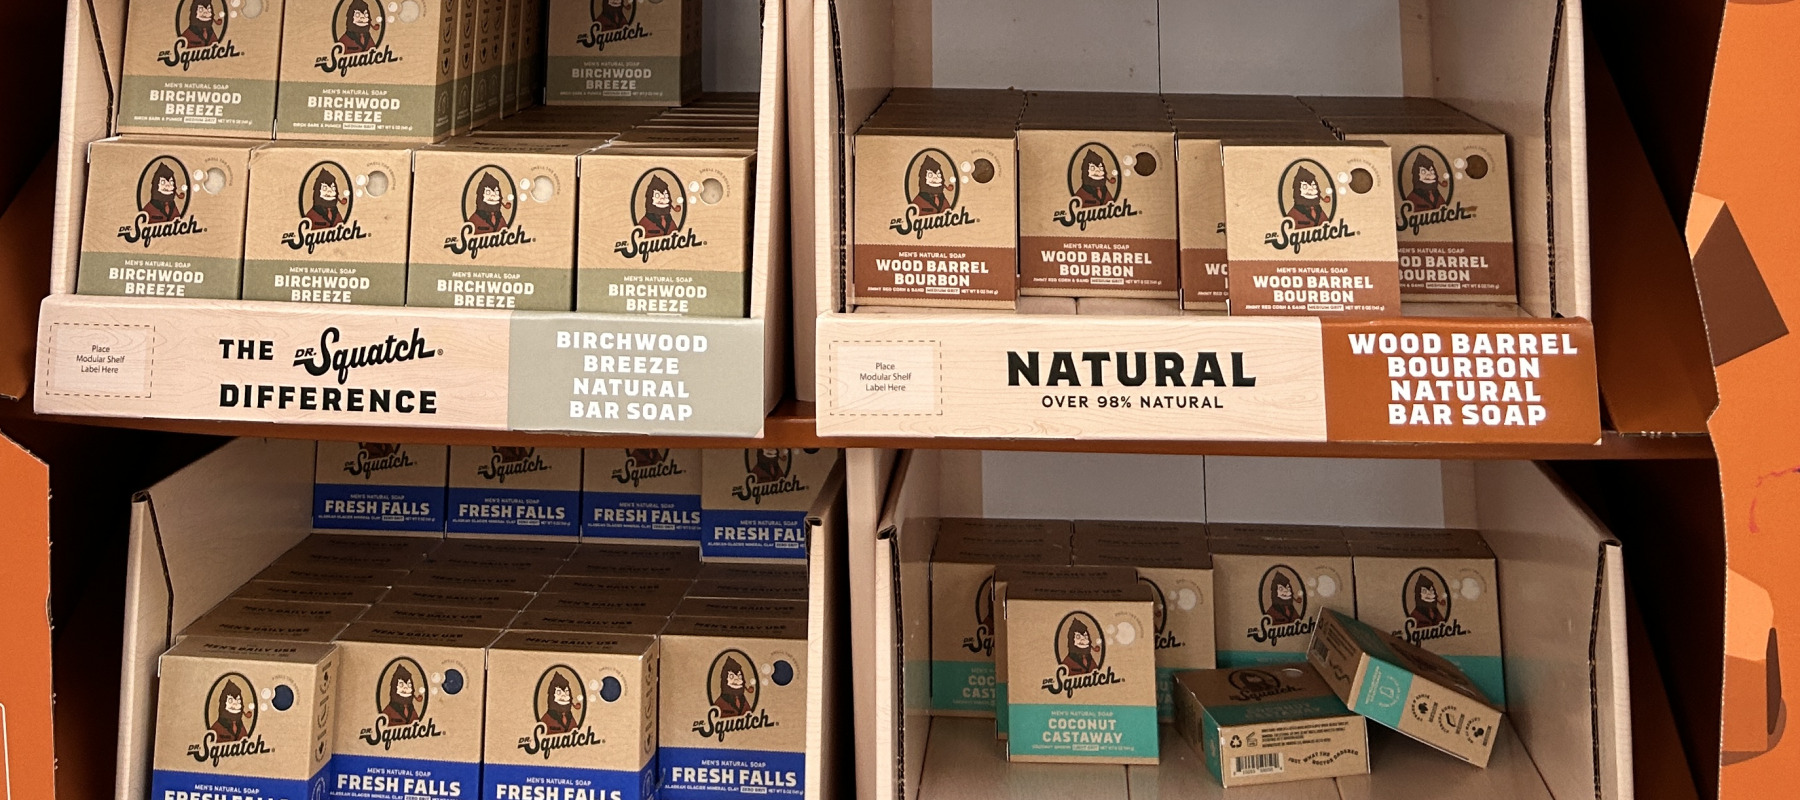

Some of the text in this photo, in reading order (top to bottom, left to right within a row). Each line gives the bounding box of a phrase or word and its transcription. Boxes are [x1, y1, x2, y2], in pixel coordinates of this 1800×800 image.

[572, 68, 652, 78] BIRCHWOOD
[586, 80, 636, 90] BREEZE
[150, 90, 241, 104] BIRCHWOOD
[308, 96, 400, 110] BIRCHWOOD
[165, 103, 224, 116] BREEZE
[324, 110, 382, 122] BREEZE
[1041, 250, 1152, 264] WOOD BARREL
[1426, 256, 1488, 268] BARREL
[876, 259, 989, 274] WOOD BARREL
[1060, 264, 1134, 278] BOURBON
[109, 268, 204, 284] BIRCHWOOD
[274, 274, 370, 290] BIRCHWOOD
[894, 273, 970, 286] BOURBON
[1252, 276, 1374, 288] WOOD BARREL
[125, 282, 185, 296] BREEZE
[437, 280, 534, 294] BIRCHWOOD
[608, 284, 707, 298] BIRCHWOOD
[291, 290, 352, 302] BREEZE
[454, 294, 516, 308] BREEZE
[1274, 290, 1354, 302] BOURBON
[626, 298, 688, 312] BREEZE
[556, 330, 708, 352] BIRCHWOOD
[1348, 333, 1578, 355] WOOD BARREL
[219, 339, 273, 360] THE
[76, 354, 105, 362] Modular
[584, 354, 680, 376] BREEZE
[102, 366, 118, 374] Here
[876, 362, 895, 370] Place
[1007, 350, 1256, 388] NATURAL
[1388, 356, 1540, 378] BOURBON
[893, 372, 912, 380] Shelf
[573, 377, 690, 399] NATURAL
[866, 384, 906, 392] Label Here
[1391, 380, 1542, 402] NATURAL
[219, 384, 437, 414] DIFFERENCE
[1042, 396, 1224, 409] OVER 98% NATURAL
[570, 400, 693, 422] BAR SOAP
[1388, 404, 1547, 426] BAR SOAP
[325, 500, 430, 516] FRESH FALLS
[459, 504, 566, 520] FRESH FALLS
[594, 508, 700, 524] FRESH FALLS
[714, 526, 770, 540] FRESH
[1048, 718, 1116, 730] COCONUT
[1042, 731, 1122, 744] CASTAWAY
[721, 760, 748, 768] NATURAL
[386, 768, 413, 776] NATURAL
[672, 766, 797, 787] FRESH FALLS
[338, 774, 398, 792] FRESH
[404, 778, 461, 796] FALLS
[546, 778, 573, 786] NATURAL
[496, 784, 558, 800] FRESH
